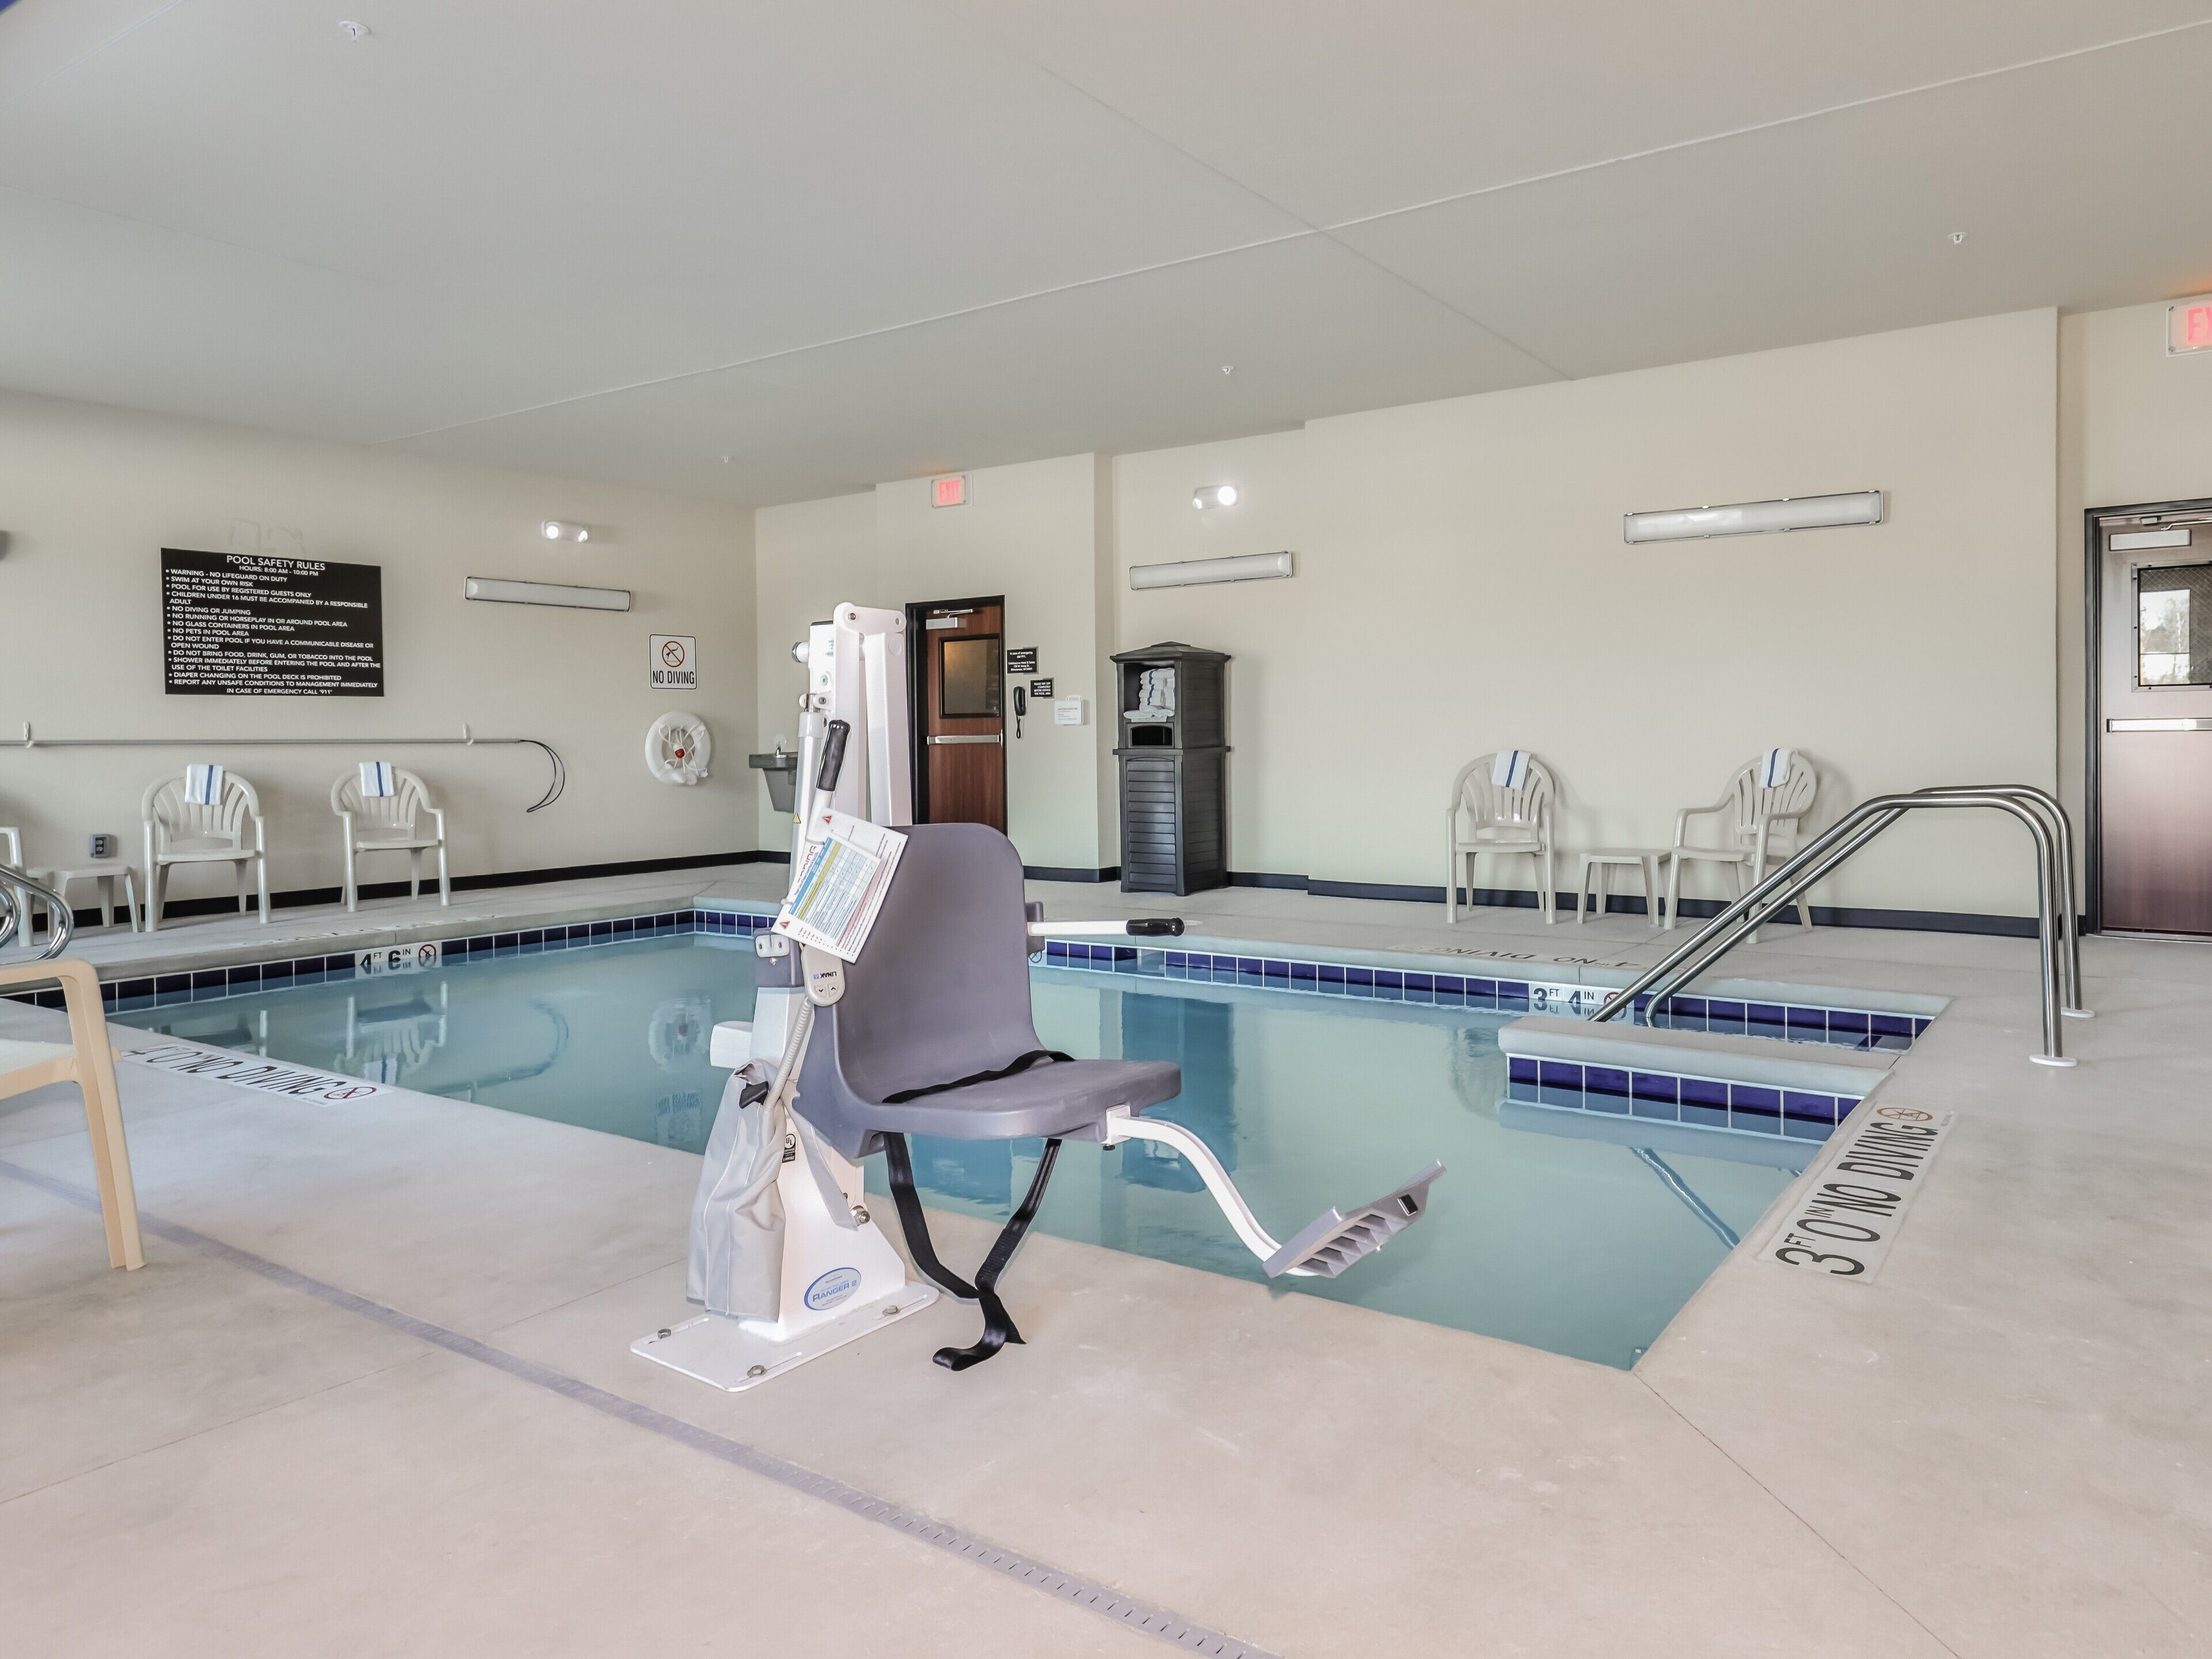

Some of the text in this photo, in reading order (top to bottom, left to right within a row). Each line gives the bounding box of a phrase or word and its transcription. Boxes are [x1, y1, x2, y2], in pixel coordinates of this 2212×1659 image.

[226, 555, 325, 570] POOL SAFETY RULES
[653, 671, 695, 684] NO DIVING
[1549, 988, 1559, 997] FT
[1584, 991, 1594, 1000] IN
[169, 1056, 244, 1074] NO
[215, 1066, 347, 1096] DIVING
[1836, 1122, 1939, 1181] DIVING
[1811, 1183, 1902, 1217] NO
[1804, 1206, 1835, 1218] IN
[1783, 1233, 1816, 1248] FT
[1775, 1247, 1865, 1275] 3
[812, 1283, 850, 1302] RANGER
